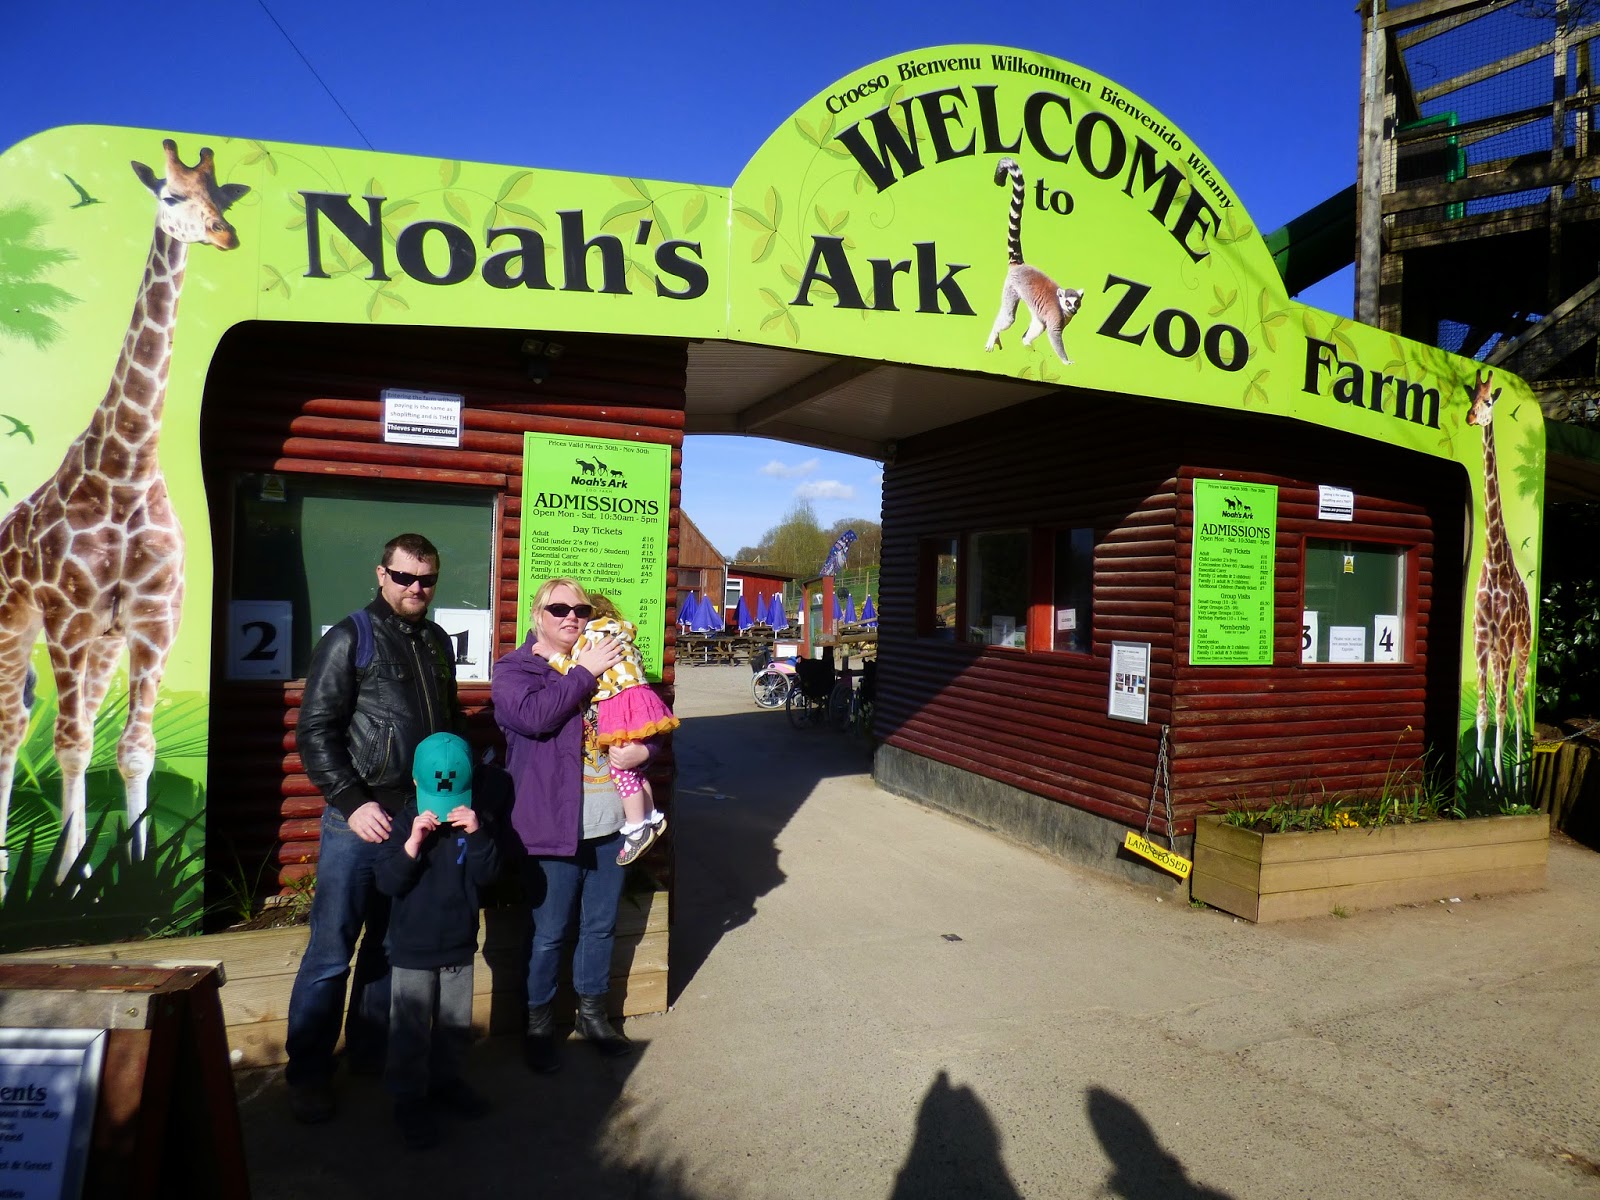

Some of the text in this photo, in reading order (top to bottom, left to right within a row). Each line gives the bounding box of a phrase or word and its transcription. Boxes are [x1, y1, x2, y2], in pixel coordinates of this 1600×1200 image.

[825, 54, 1234, 208] Croeso Bienvenu Wilkommen Bienvenido Witamy
[834, 84, 1222, 264] WELCOME
[1033, 178, 1075, 215] to
[297, 190, 1441, 430] Noah's Ark Zoo Farm
[571, 476, 628, 488] Noah's Ark
[533, 509, 554, 517] Open
[600, 513, 634, 522] 10:30am
[641, 516, 658, 524] 5pm
[534, 492, 659, 515] ADMISSIONS
[572, 526, 623, 535] Day Tickets
[1201, 523, 1270, 539] ADMISSIONS
[240, 621, 280, 661] 2
[1302, 624, 1312, 650] 3
[1378, 626, 1394, 652] 4
[1128, 836, 1150, 854] LANE
